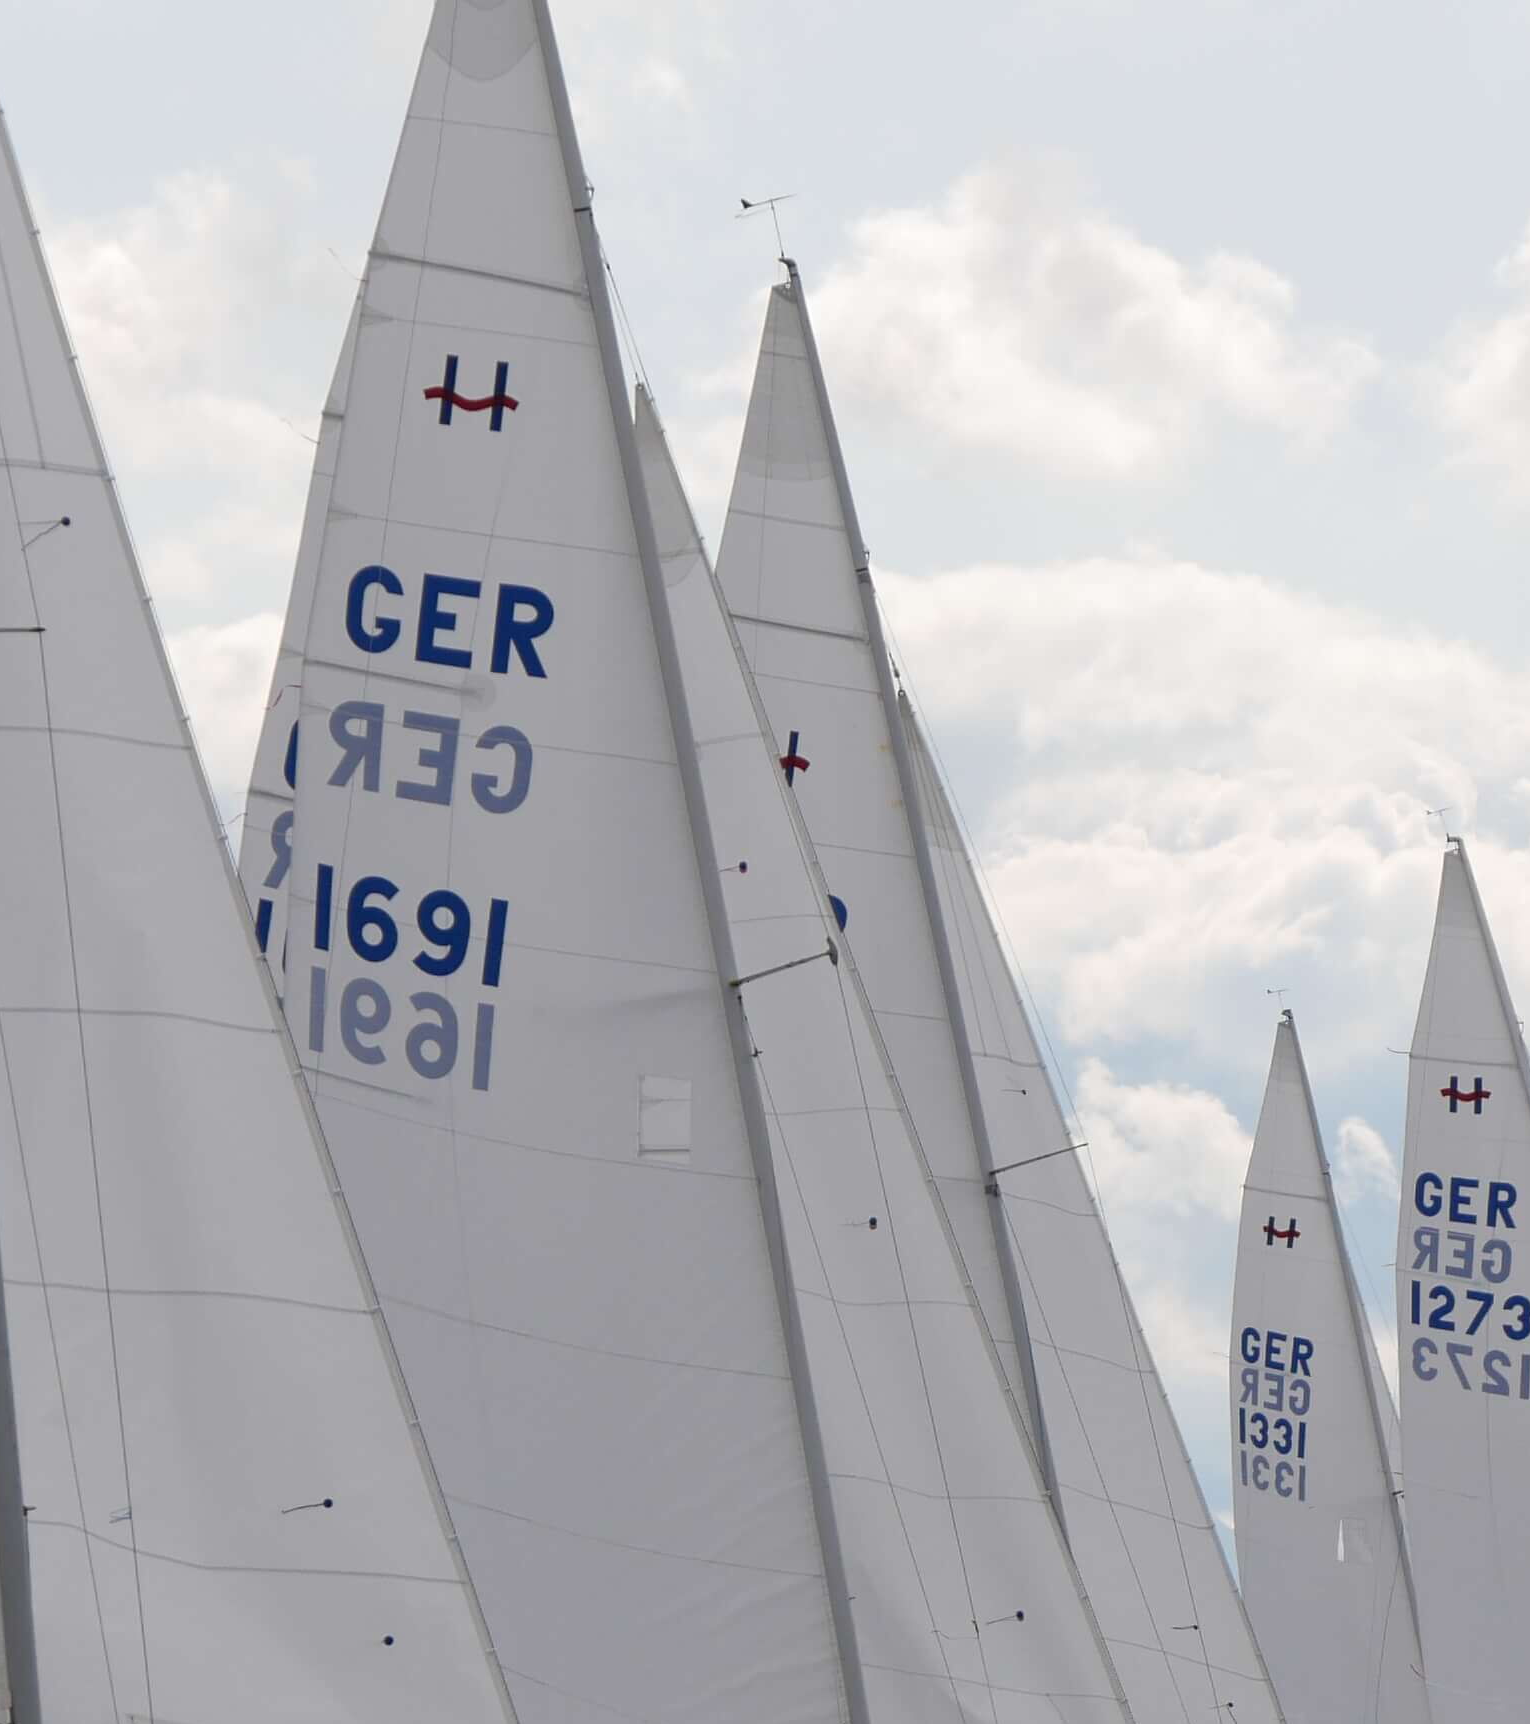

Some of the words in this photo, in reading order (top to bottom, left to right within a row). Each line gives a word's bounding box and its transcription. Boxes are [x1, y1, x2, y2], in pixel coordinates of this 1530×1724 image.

[346, 566, 554, 678] GER
[315, 864, 508, 987] 1691
[1415, 1173, 1516, 1228] GER
[1242, 1328, 1313, 1377] GER
[1239, 1408, 1306, 1458] 1331
